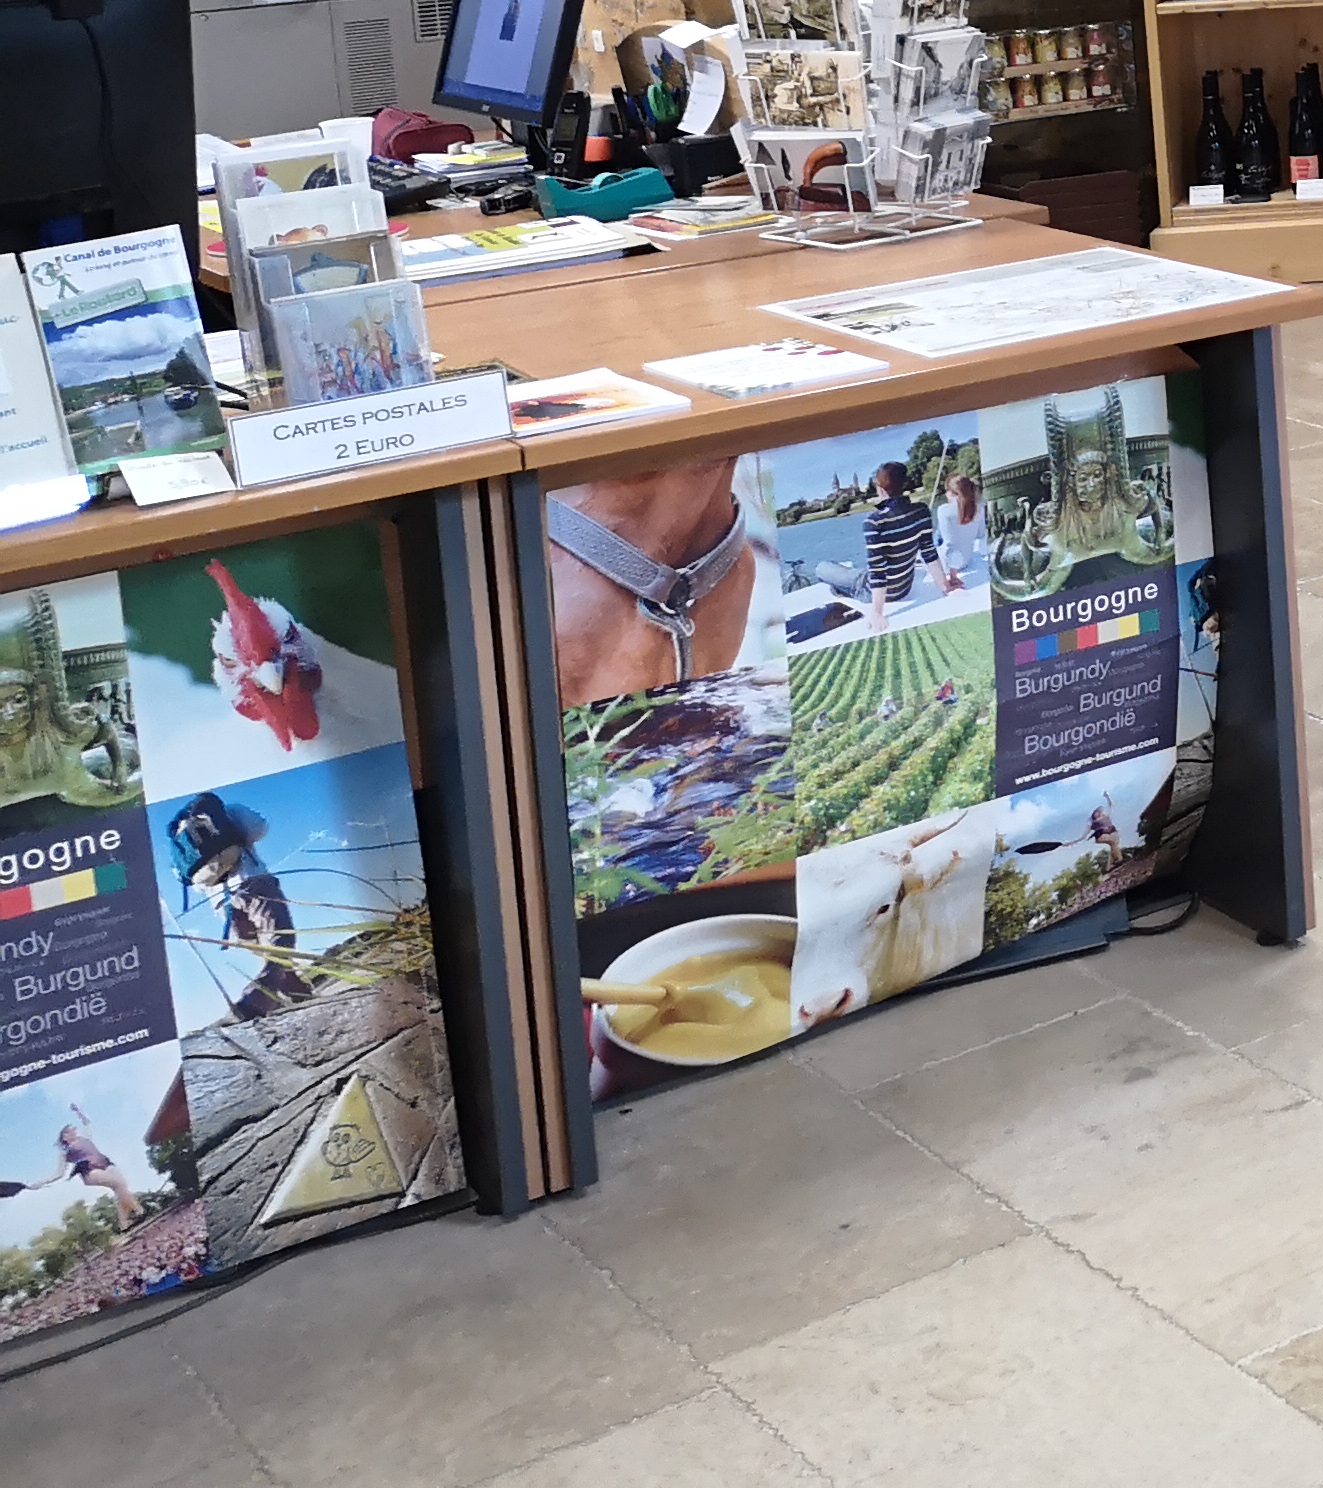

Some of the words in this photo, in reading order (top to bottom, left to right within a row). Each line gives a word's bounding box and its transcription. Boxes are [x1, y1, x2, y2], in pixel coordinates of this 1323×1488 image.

[64, 249, 95, 263] Canal
[98, 247, 112, 258] de
[113, 236, 176, 255] Bourgogne
[273, 414, 357, 441] CARTES
[362, 393, 468, 426] POSTALES
[335, 443, 350, 460] 2
[356, 433, 415, 456] EURO
[1011, 582, 1159, 634] Bourgogne
[1015, 659, 1112, 699] Burgundy
[1079, 674, 1162, 712] Burgund
[1024, 708, 1136, 755] Bourgondië
[1014, 736, 1159, 785] www.bourgogne-tourisme.com
[14, 944, 140, 1002] Burgund
